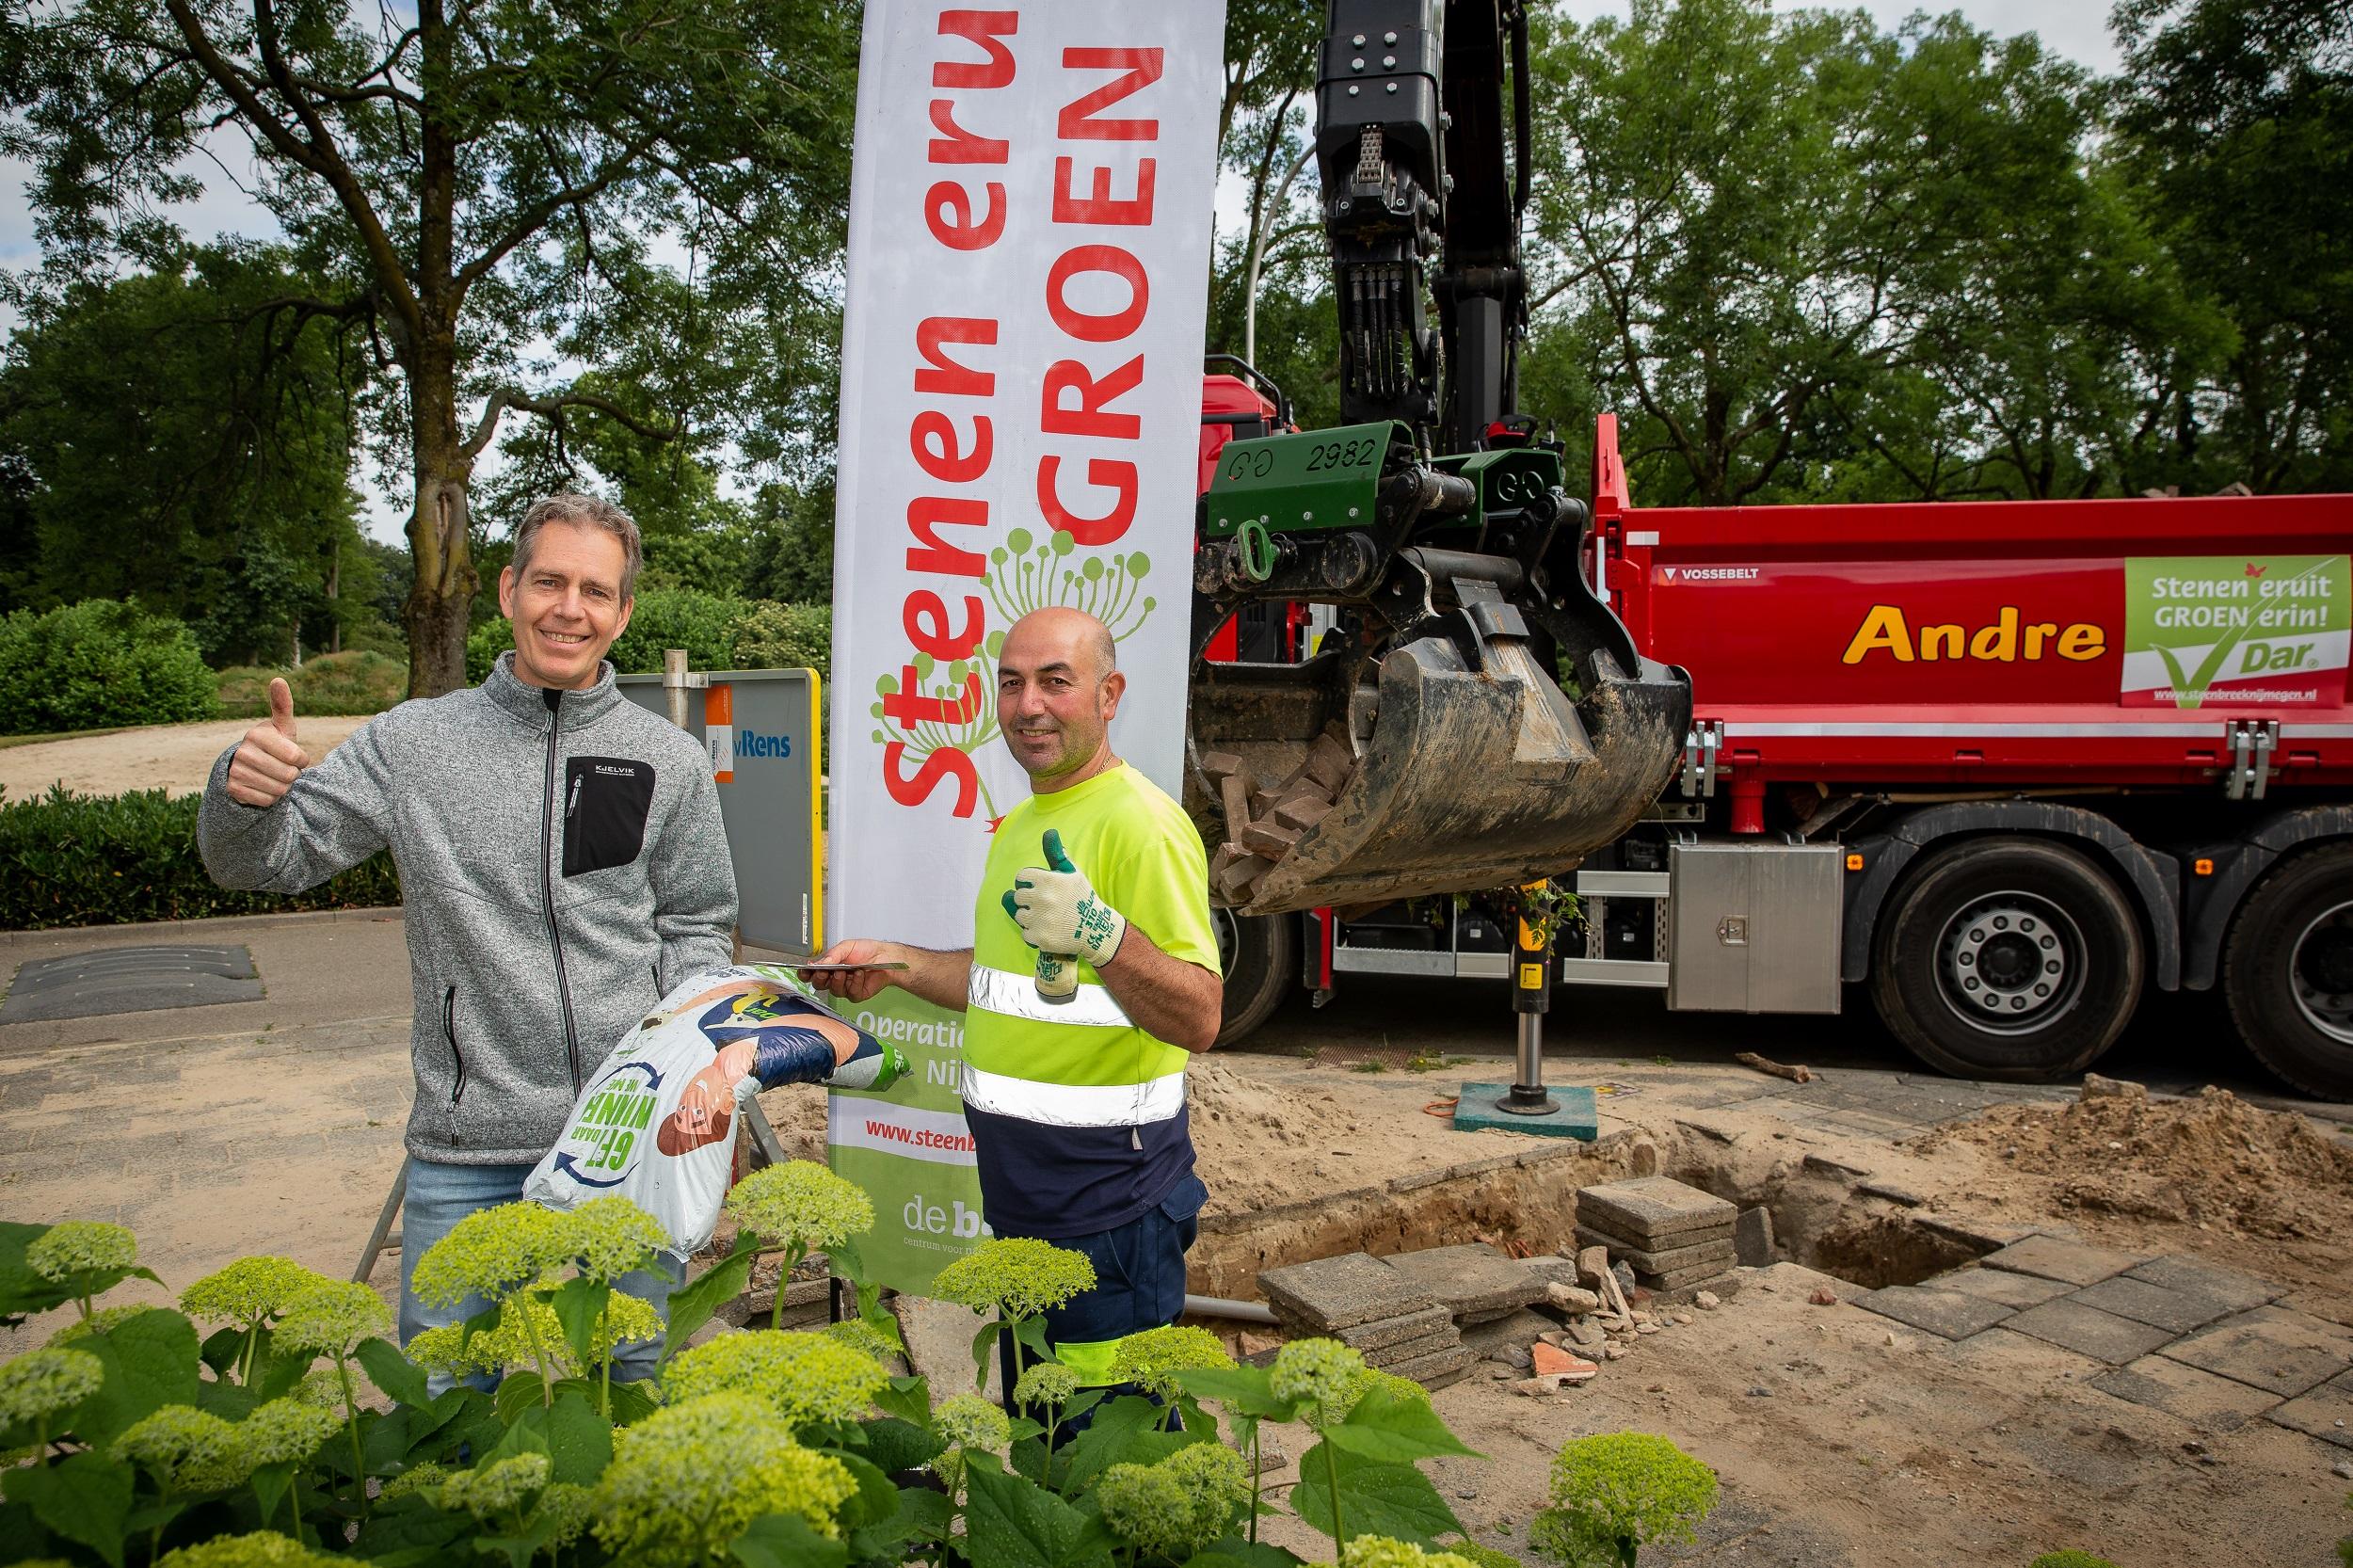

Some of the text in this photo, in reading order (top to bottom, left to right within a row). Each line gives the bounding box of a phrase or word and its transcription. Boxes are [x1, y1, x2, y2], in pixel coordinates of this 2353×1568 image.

[1036, 47, 1164, 546] GROEN
[1306, 439, 1376, 472] 2982
[883, 316, 999, 818] Stenen
[1681, 568, 1759, 580] VOSSEBELT
[2153, 574, 2332, 599] Stenen eruit
[2153, 603, 2328, 628] GROEN erin!
[1841, 603, 2108, 665] Andre
[595, 764, 635, 775] KJELVIK
[904, 1194, 947, 1235] de
[904, 1237, 940, 1251] centrum
[942, 1244, 964, 1255] voor
